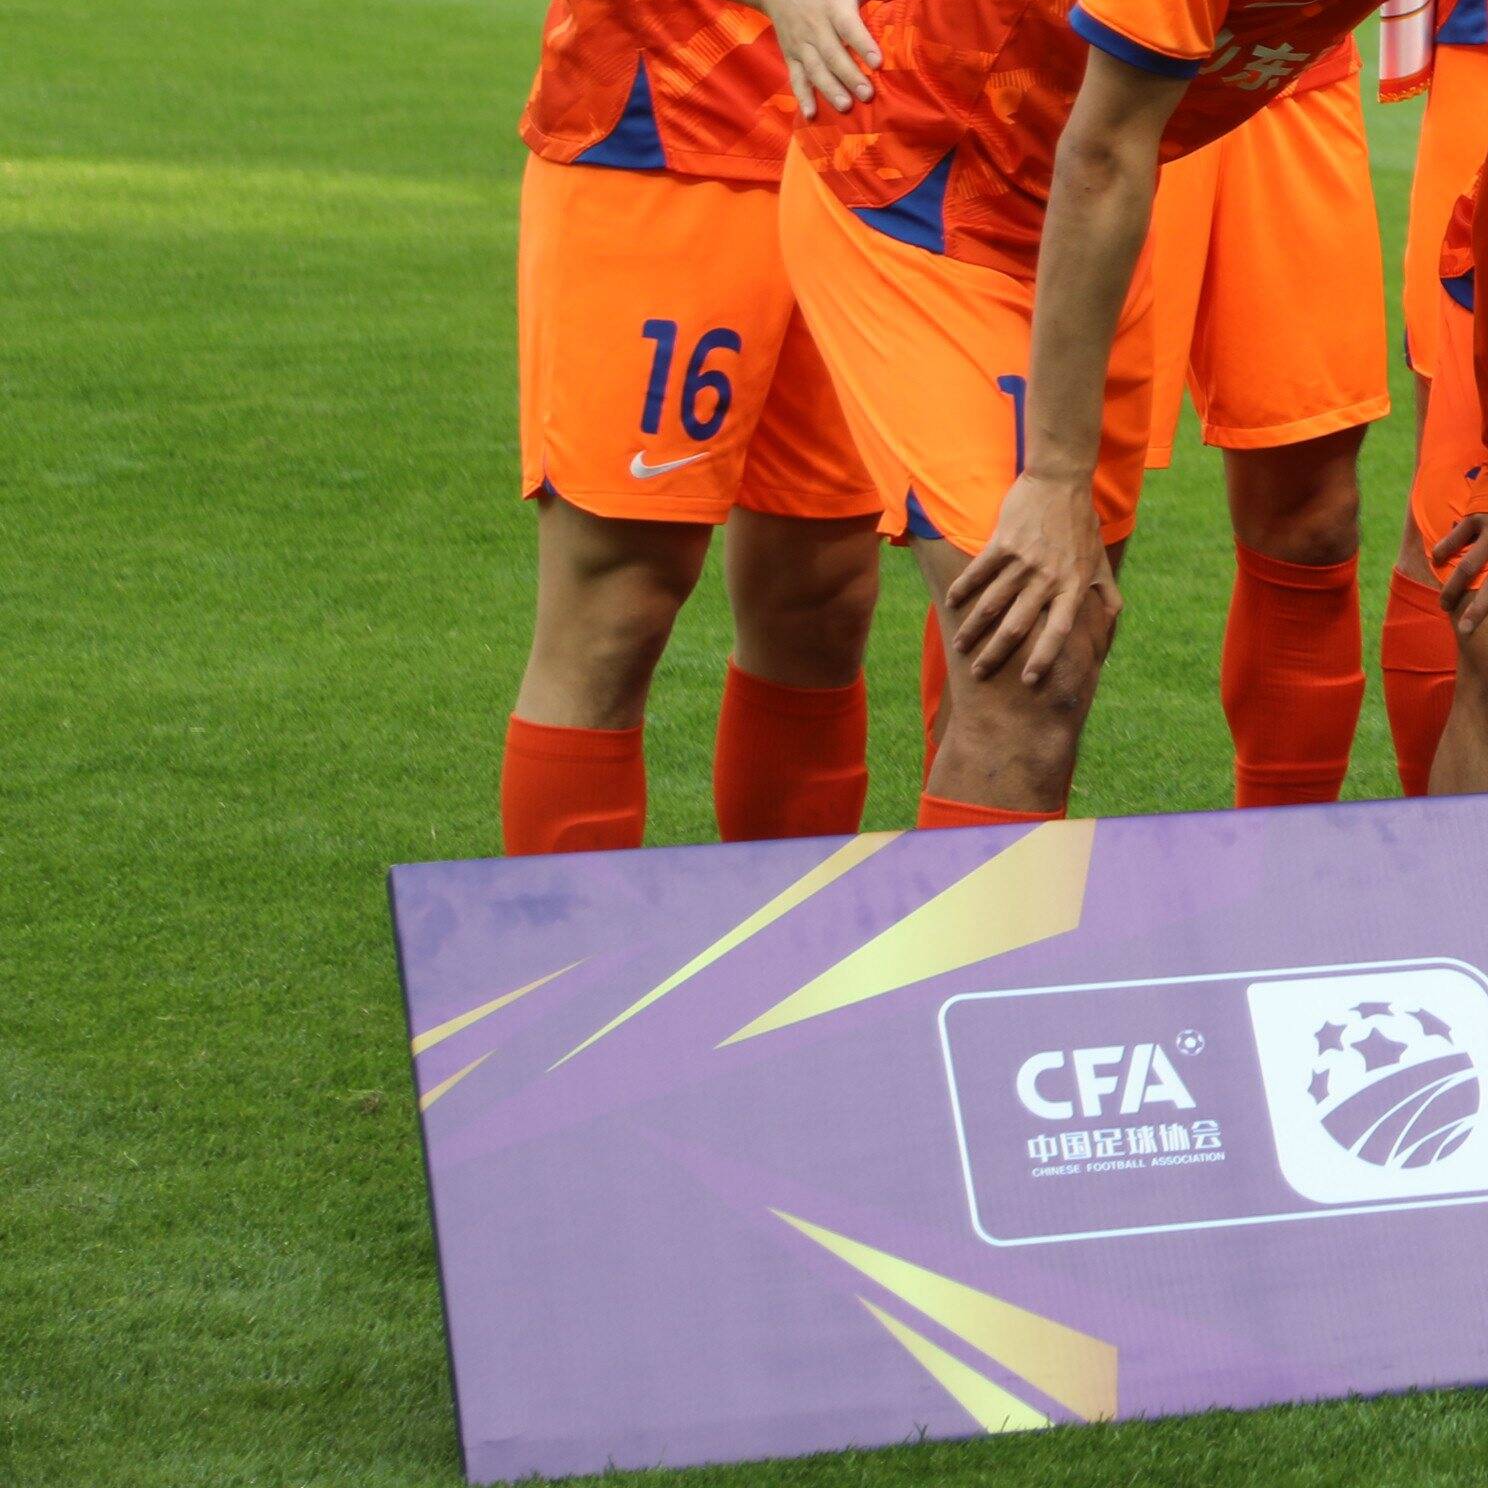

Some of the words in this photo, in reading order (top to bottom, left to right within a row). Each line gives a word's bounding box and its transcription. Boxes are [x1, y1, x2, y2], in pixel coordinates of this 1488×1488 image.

[640, 318, 743, 441] 16
[1016, 1043, 1197, 1120] CFA
[1026, 1118, 1223, 1164] 中国足球协会
[1031, 1163, 1081, 1179] CHINESE
[1086, 1159, 1147, 1174] FOOTBALL
[1150, 1151, 1226, 1168] ASSOCIATION
